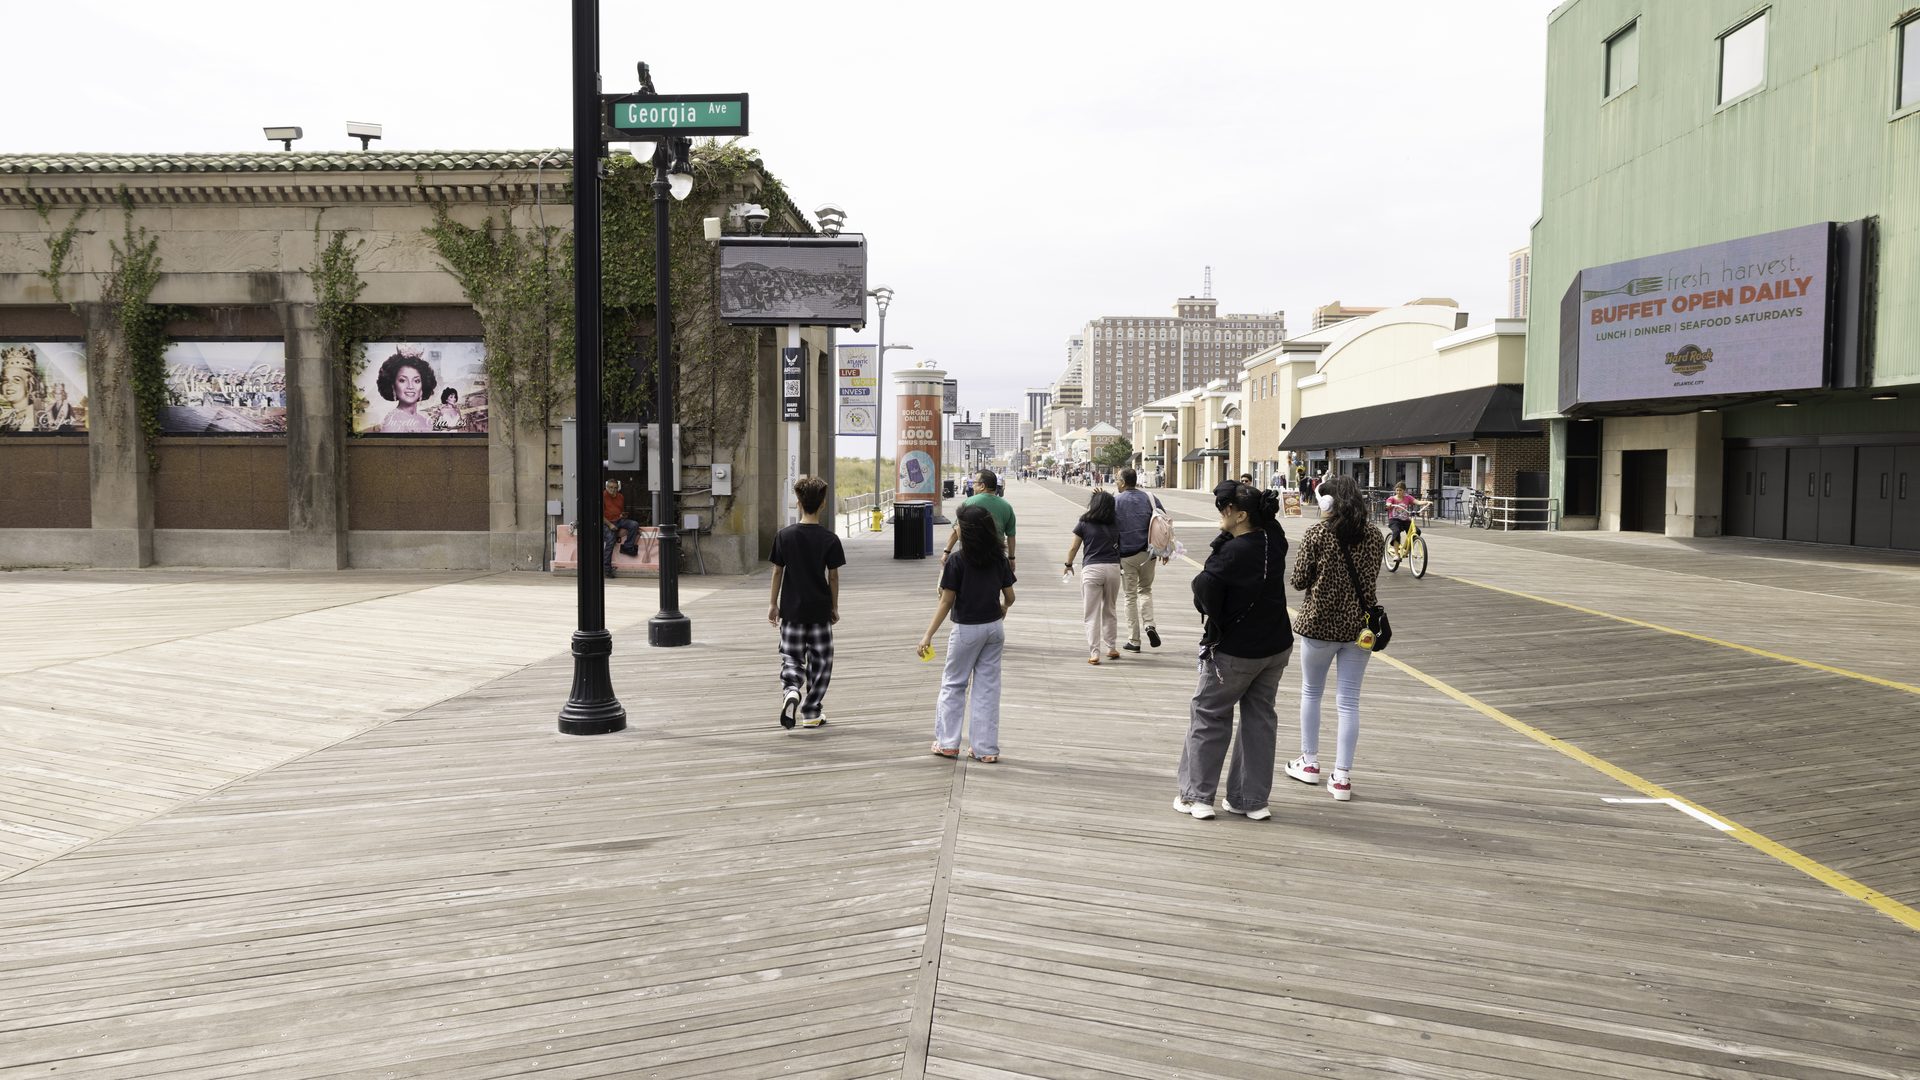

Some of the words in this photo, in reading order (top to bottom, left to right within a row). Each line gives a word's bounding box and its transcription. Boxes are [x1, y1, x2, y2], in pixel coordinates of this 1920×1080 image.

[628, 103, 696, 127] Georgia
[708, 102, 727, 114] Ave
[1667, 264, 1710, 291] fresh
[1591, 298, 1667, 325] BUFFET
[1671, 288, 1734, 313] OPEN
[1739, 275, 1813, 305] DAILY
[1596, 330, 1626, 341] LUNCH
[1634, 324, 1671, 337] DINNER
[1680, 316, 1731, 331] SEAFOOD
[1735, 307, 1803, 324] SATURDAYS
[1665, 352, 1689, 364] Hard
[1689, 348, 1713, 362] Rock
